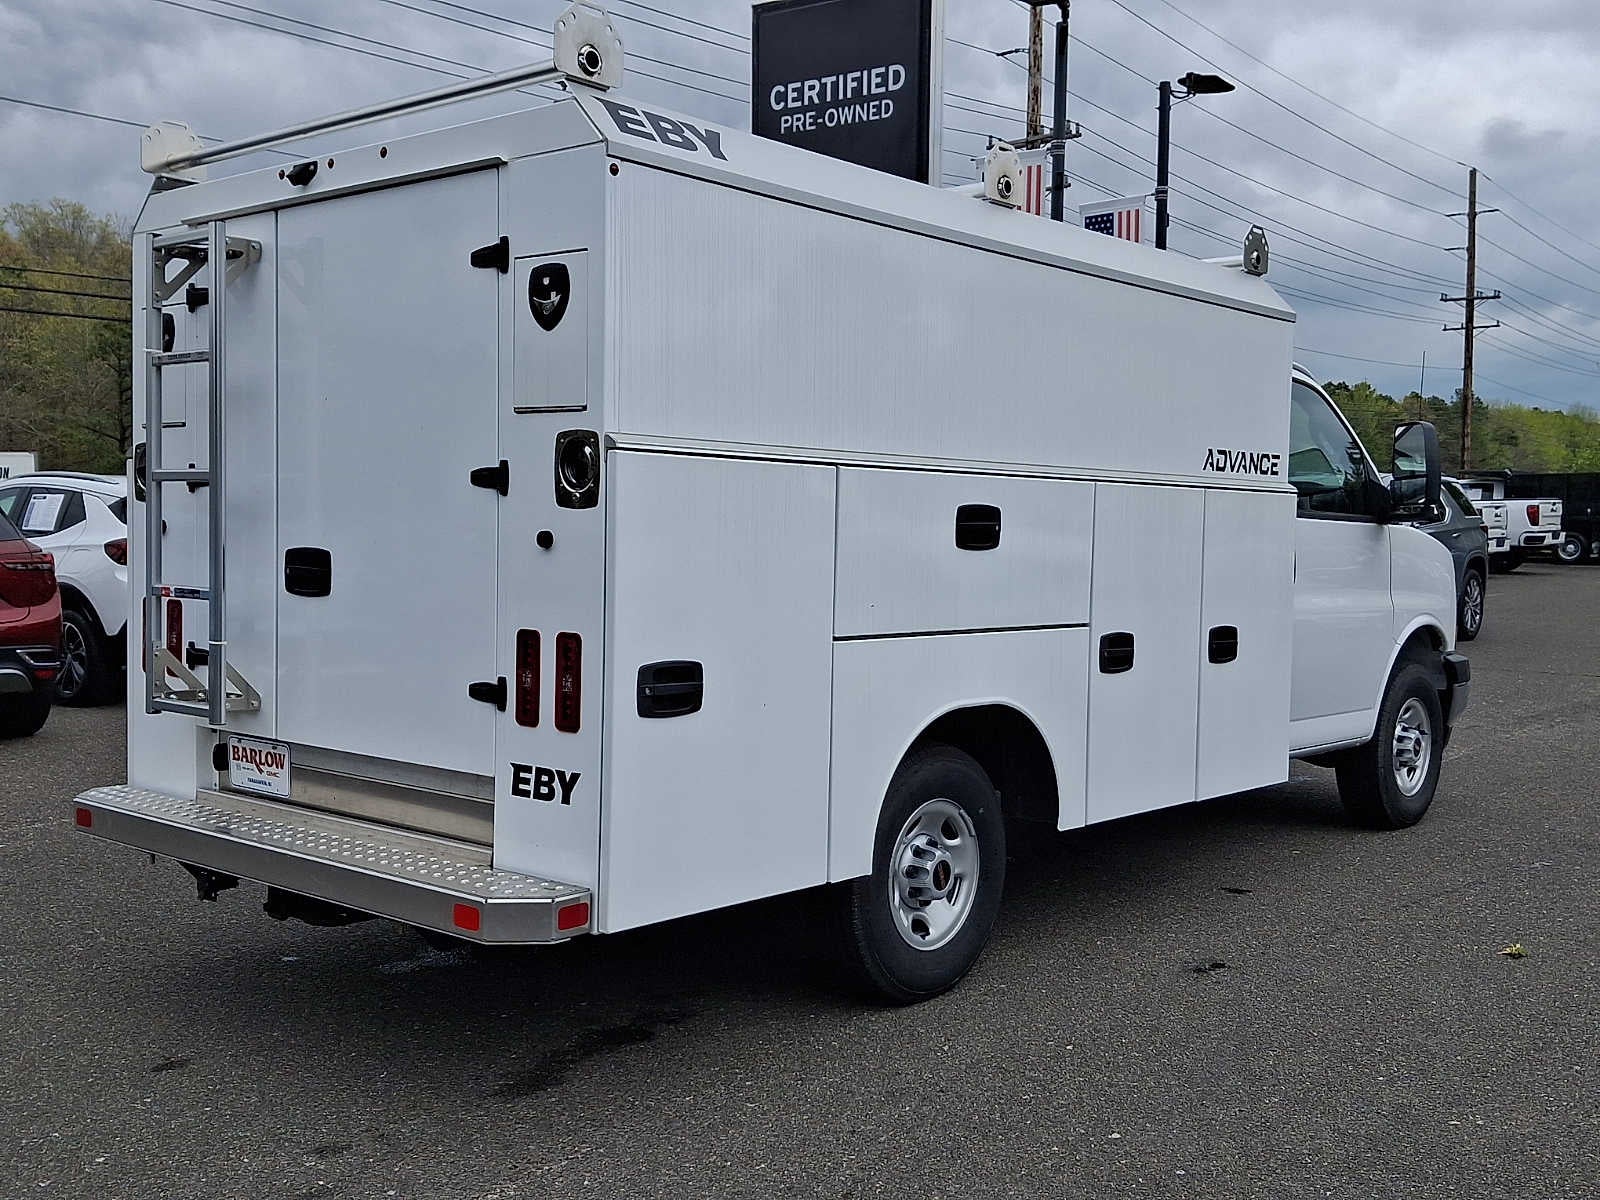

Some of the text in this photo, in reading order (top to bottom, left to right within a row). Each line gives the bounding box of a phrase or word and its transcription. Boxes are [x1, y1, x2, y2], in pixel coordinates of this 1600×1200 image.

[770, 64, 906, 111] CERTIFIED
[601, 98, 728, 161] EBY
[780, 99, 894, 134] PRE-OWNED
[1202, 448, 1281, 476] ADVANCE
[231, 744, 286, 775] BARLOW
[510, 762, 582, 805] EBY
